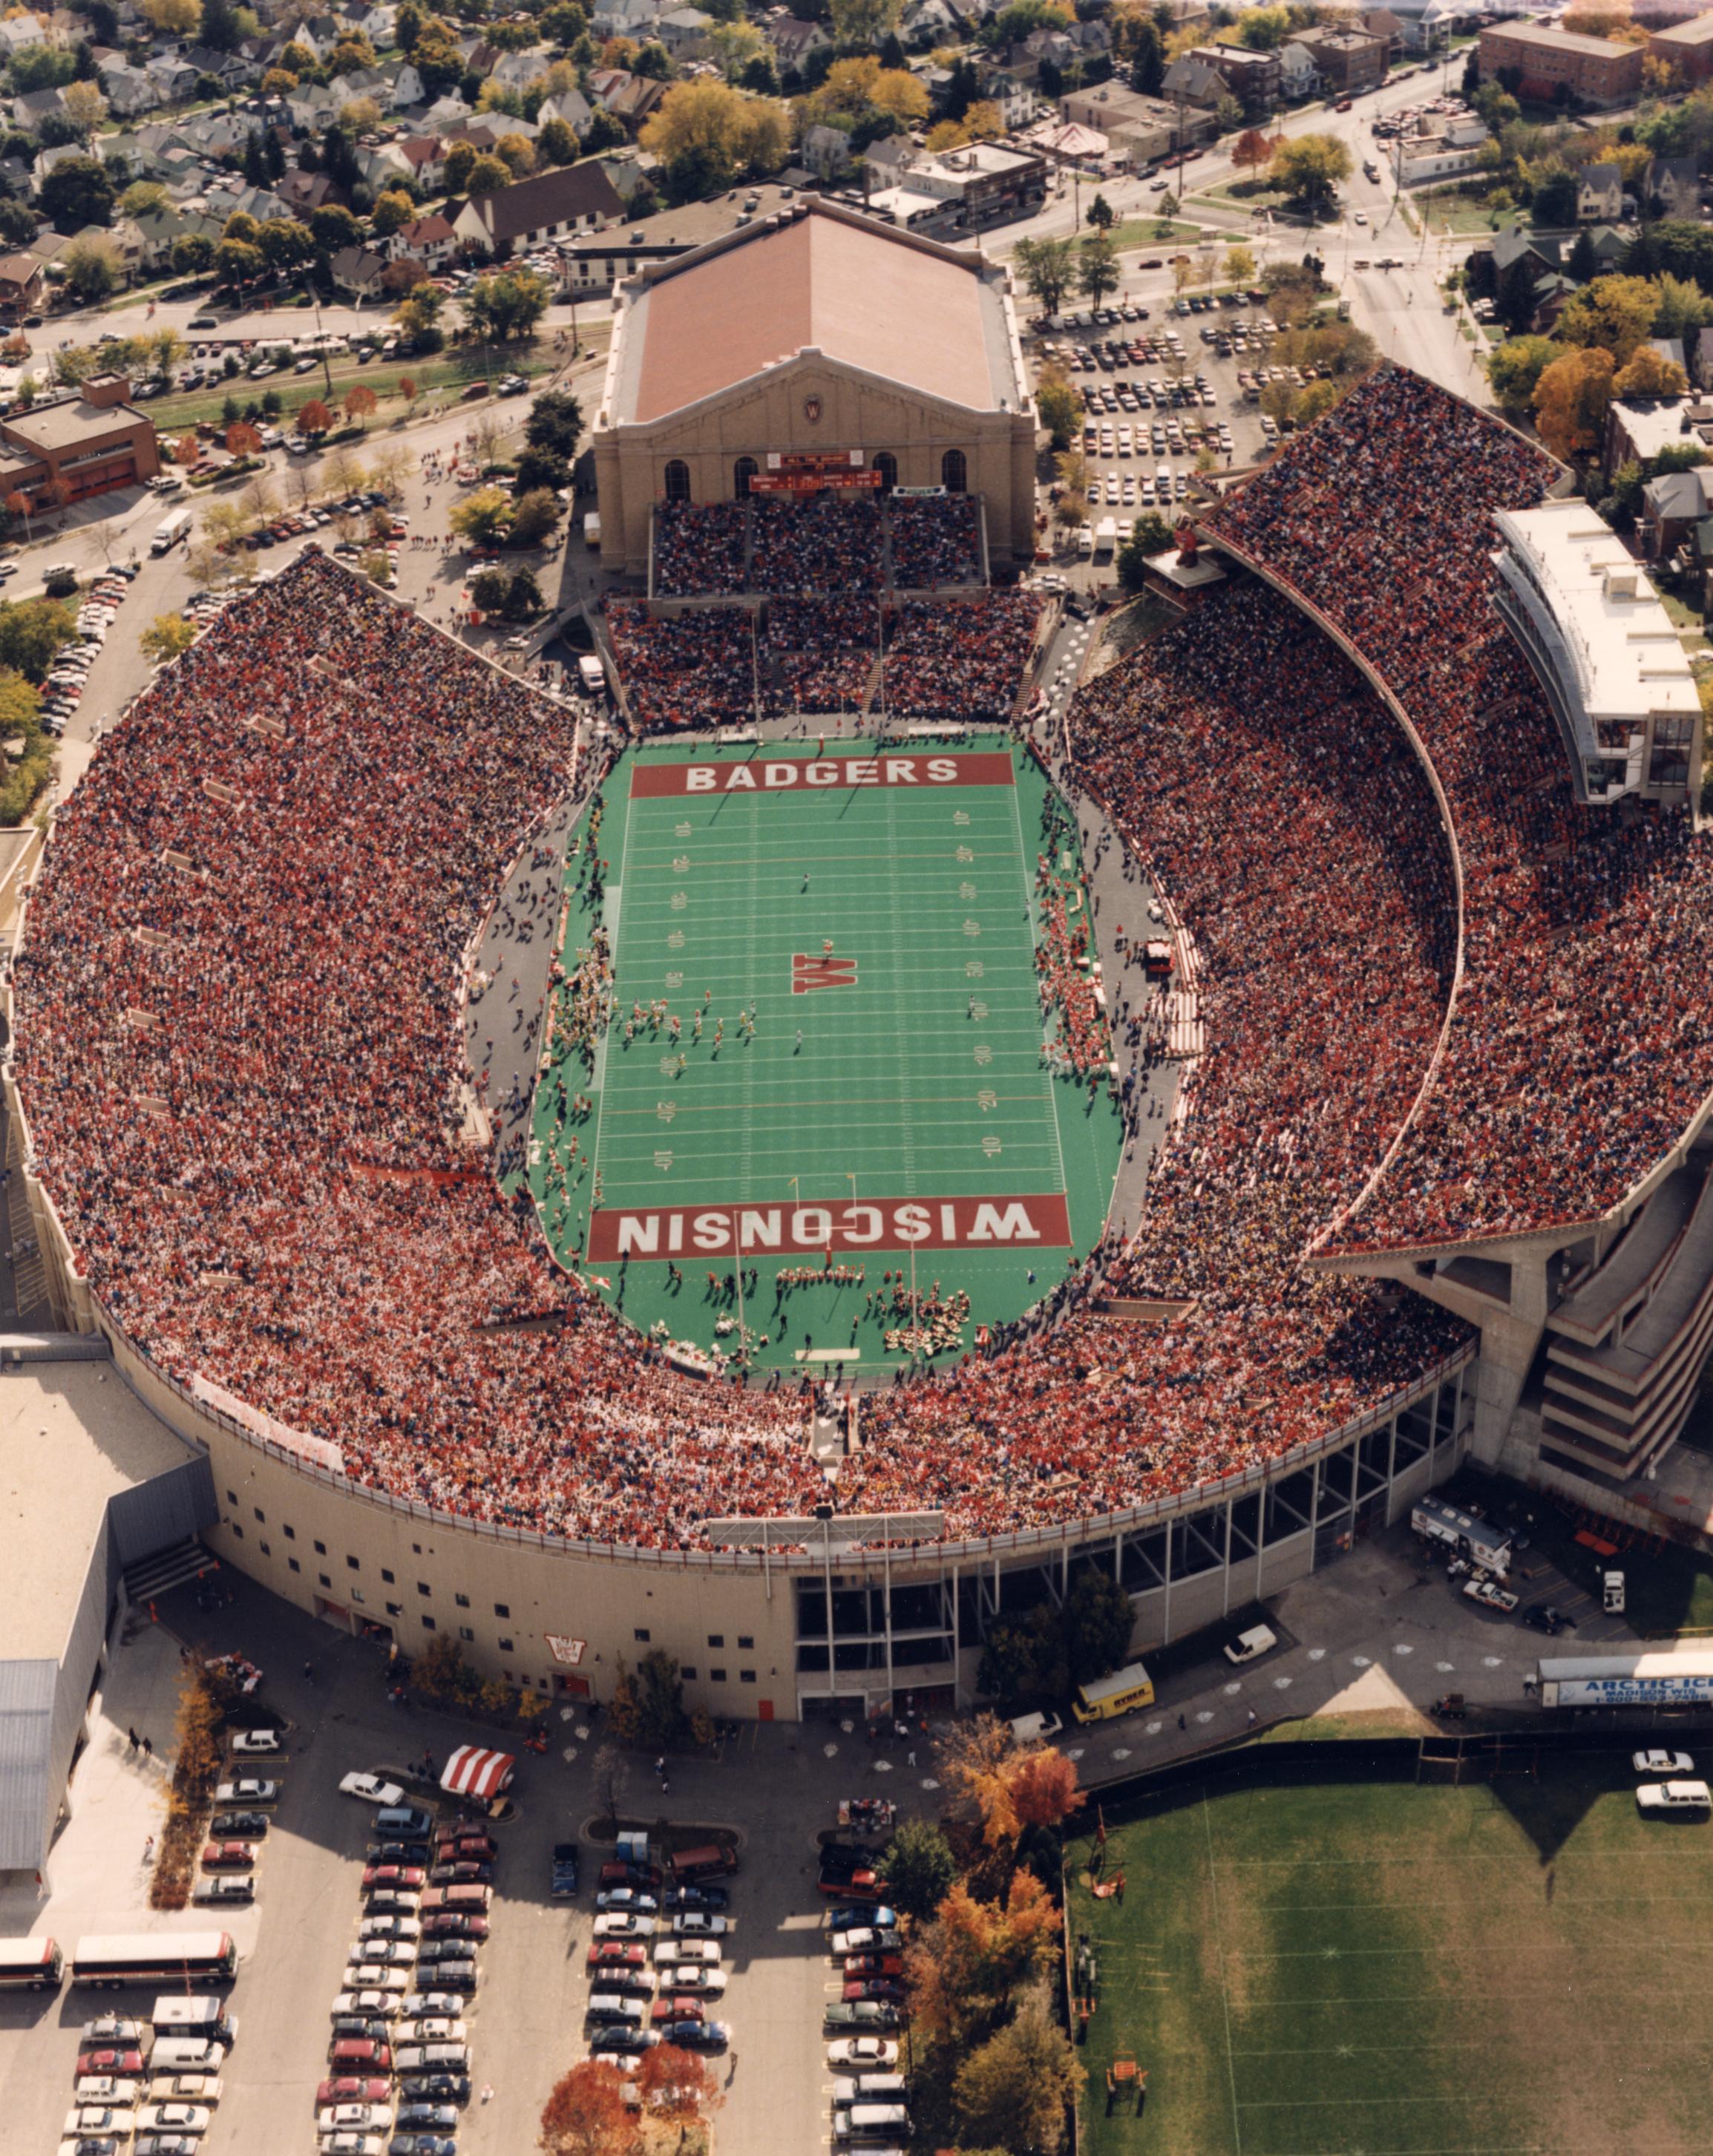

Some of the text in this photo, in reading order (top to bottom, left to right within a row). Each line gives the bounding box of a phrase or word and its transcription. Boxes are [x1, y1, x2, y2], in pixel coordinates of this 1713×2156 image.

[807, 404, 820, 419] W
[685, 758, 959, 791] BADGERS
[952, 813, 970, 825] 10
[675, 825, 692, 836] 10
[956, 848, 974, 862] 20
[673, 857, 690, 872] 20
[959, 885, 977, 900] 30
[671, 894, 688, 910] 30
[962, 923, 980, 937] 40
[668, 934, 686, 948] 40
[791, 953, 858, 995] W
[966, 962, 985, 978] 50
[665, 972, 684, 989] 50
[973, 1046, 992, 1063] 30
[660, 1056, 678, 1073] 30
[977, 1090, 998, 1108] 20
[657, 1101, 676, 1120] 20
[982, 1137, 1002, 1154] 10
[654, 1150, 673, 1167] 10
[617, 1202, 1041, 1254] WISCONSIN
[1586, 1680, 1674, 1690] ARCTIC
[1114, 1688, 1145, 1707] RYDER
